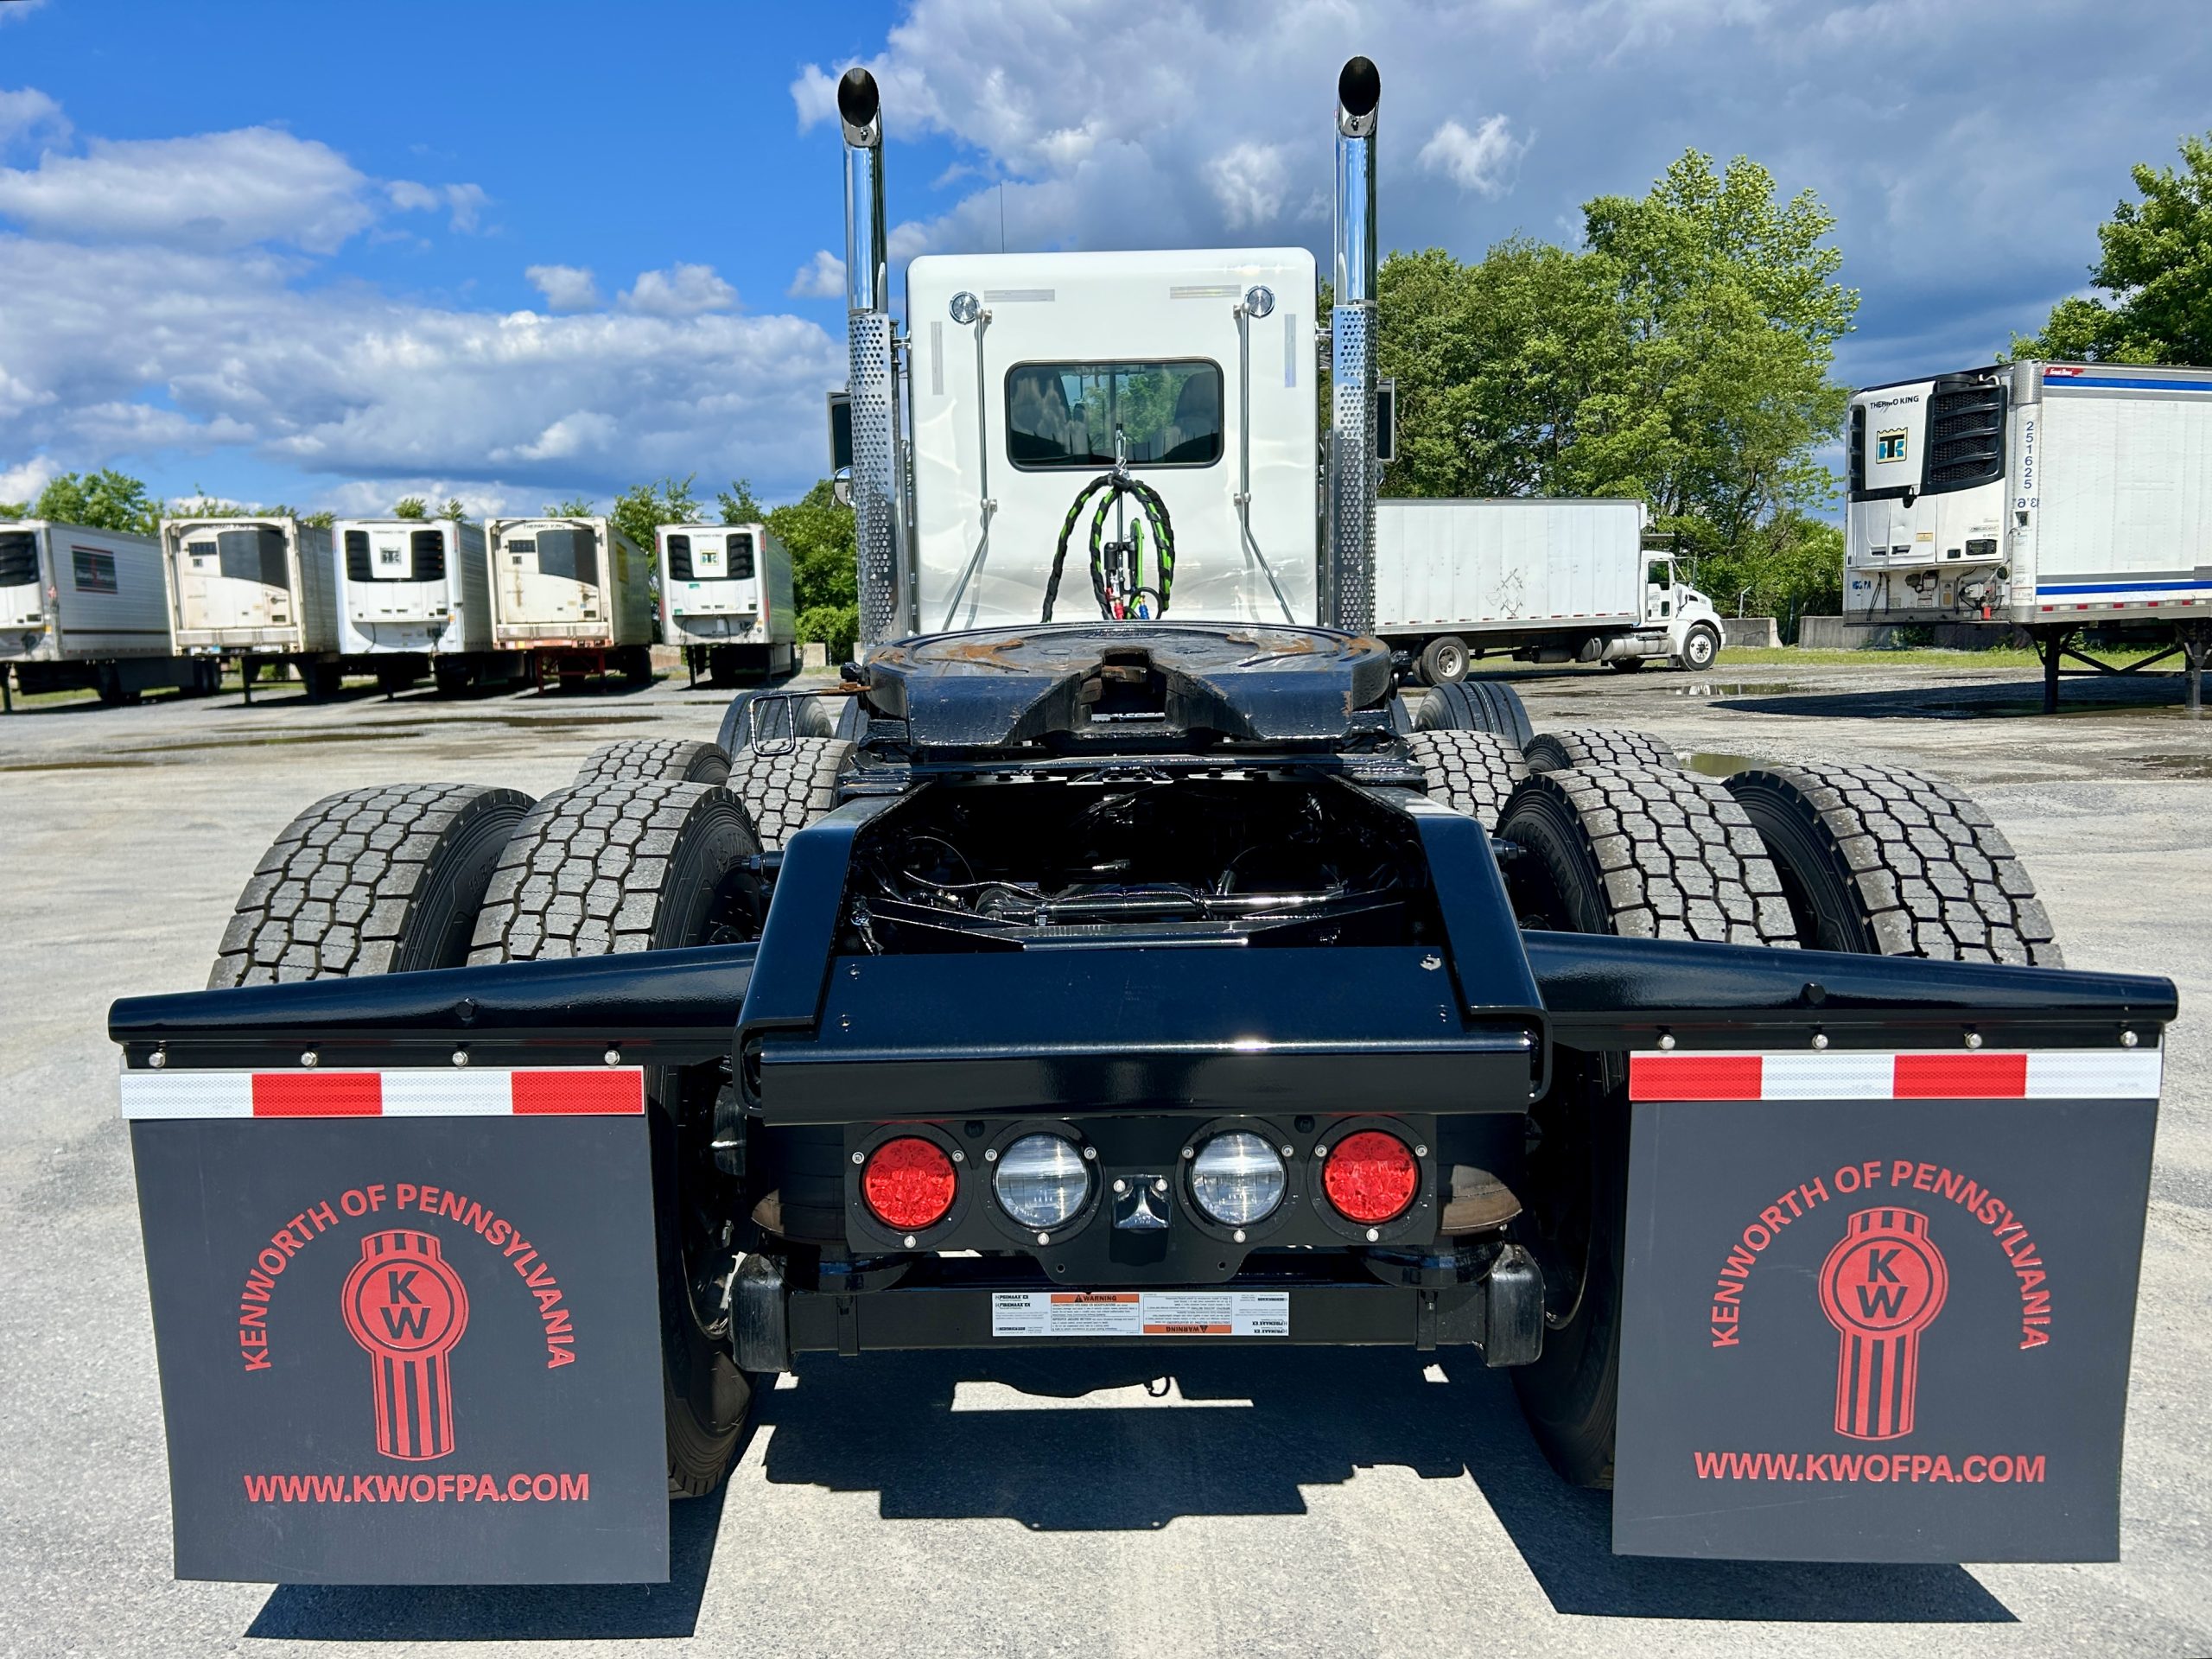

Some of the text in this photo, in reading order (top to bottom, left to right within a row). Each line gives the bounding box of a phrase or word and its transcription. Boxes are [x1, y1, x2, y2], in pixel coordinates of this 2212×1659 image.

[1870, 395, 1919, 410] THERMO KING
[1711, 1160, 2052, 1350] KENWORTH OF PENNSYLVANIA
[239, 1183, 576, 1371] KENWORTH OF PENNSYLVANIA
[1694, 1452, 2046, 1483] WWW.KWOFPA.COM
[244, 1473, 589, 1503] WWW.KWOFPA.COM
